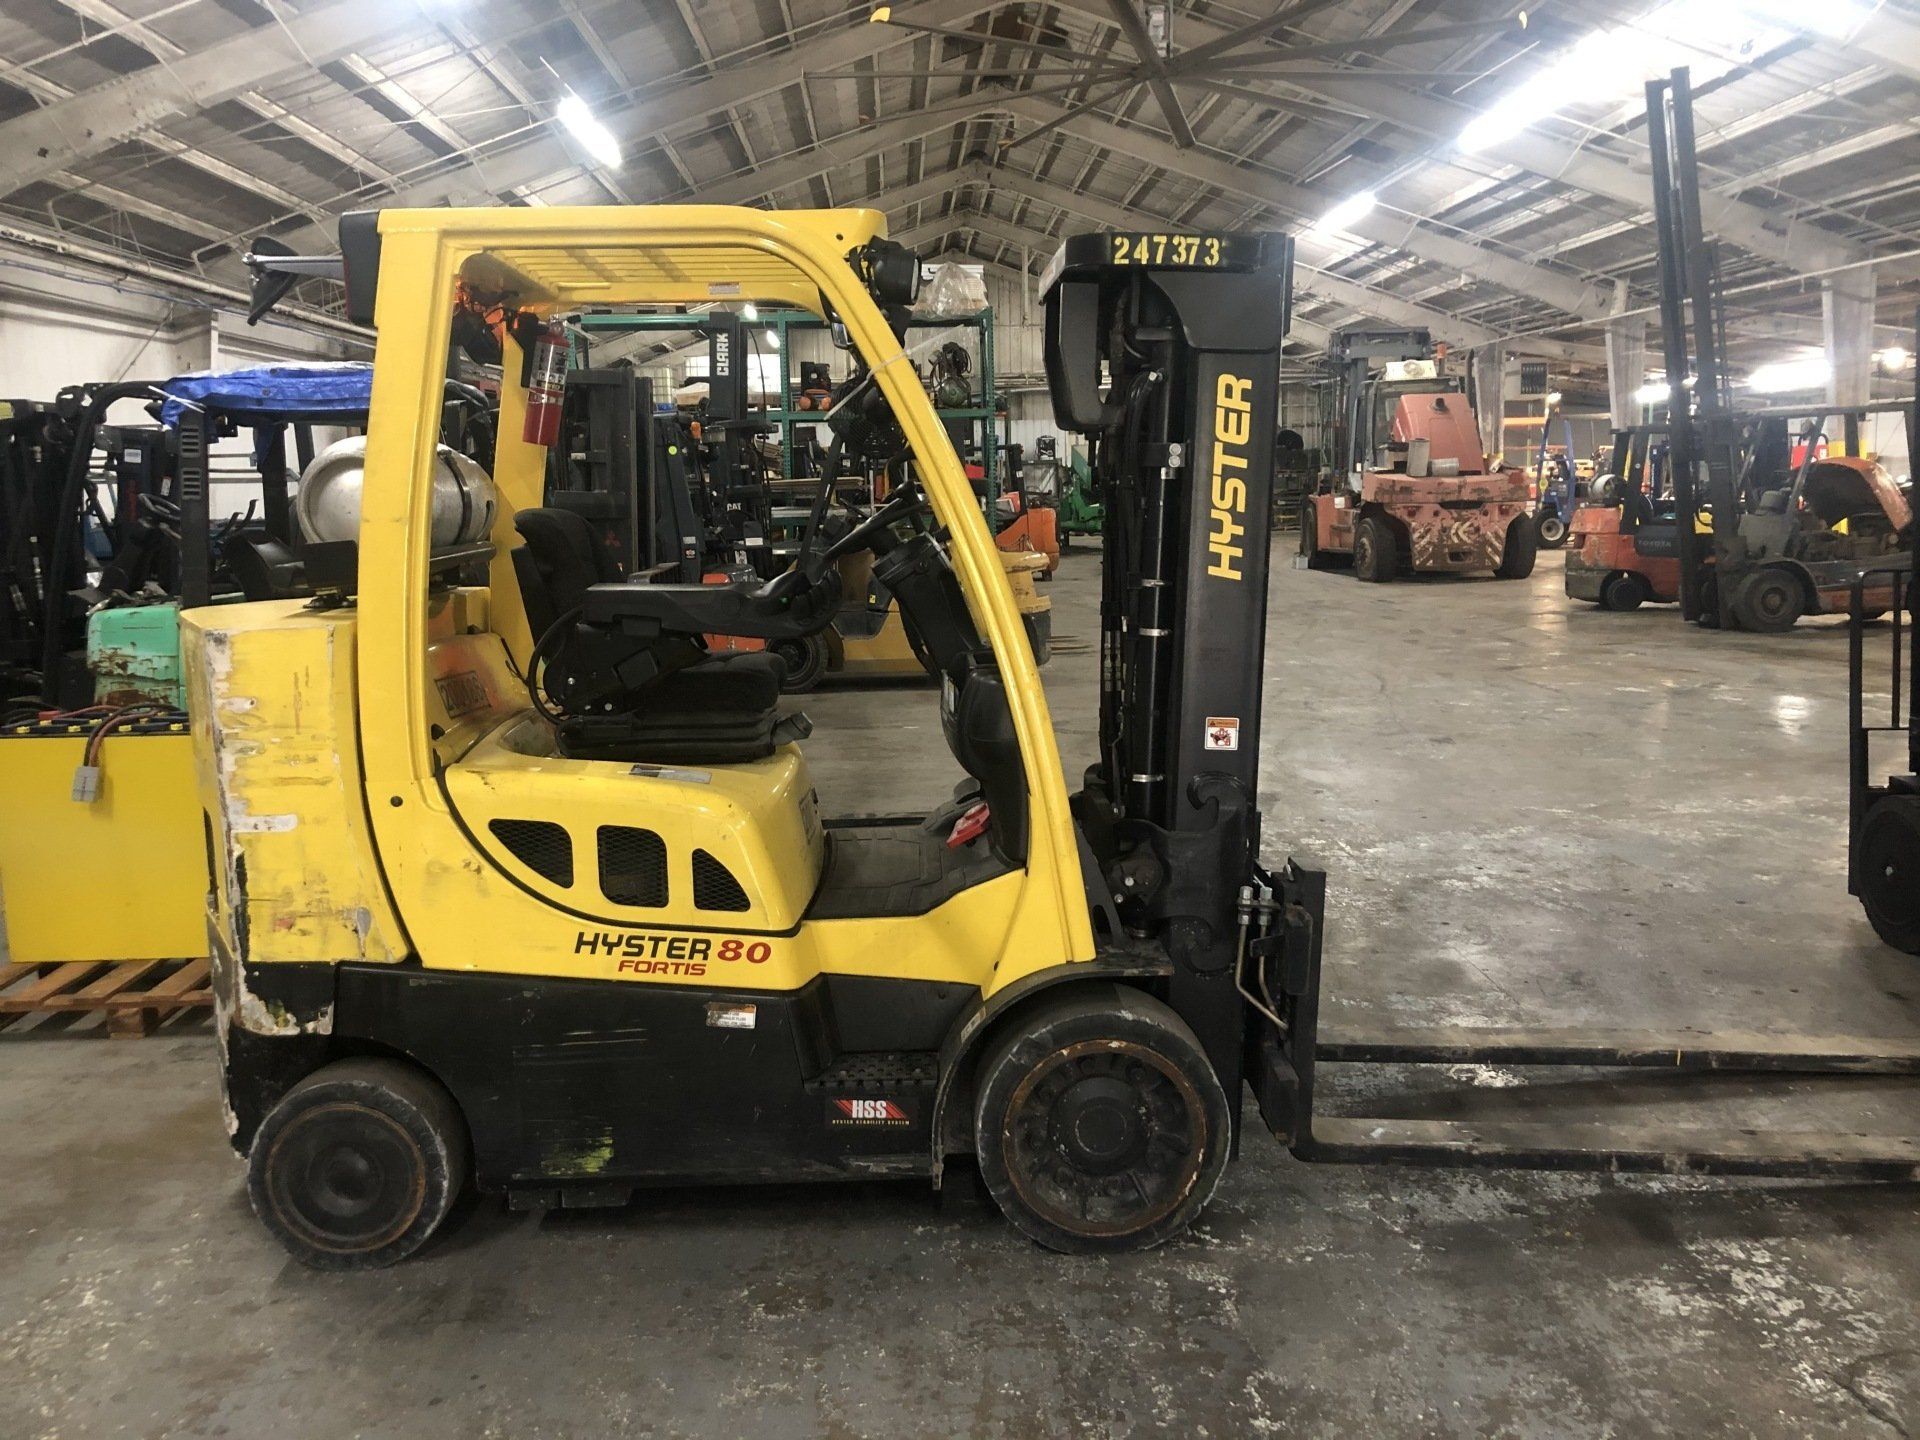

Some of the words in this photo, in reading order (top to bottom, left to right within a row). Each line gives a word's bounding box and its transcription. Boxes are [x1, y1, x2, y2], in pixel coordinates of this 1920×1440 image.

[1114, 234, 1220, 266] 247373
[716, 333, 729, 376] CLARK
[1207, 373, 1252, 581] HYSTER
[726, 502, 742, 511] CAT
[574, 932, 712, 960] HYSTER
[717, 939, 772, 964] 80
[618, 960, 707, 976] FORTIS
[852, 1100, 887, 1118] HSS
